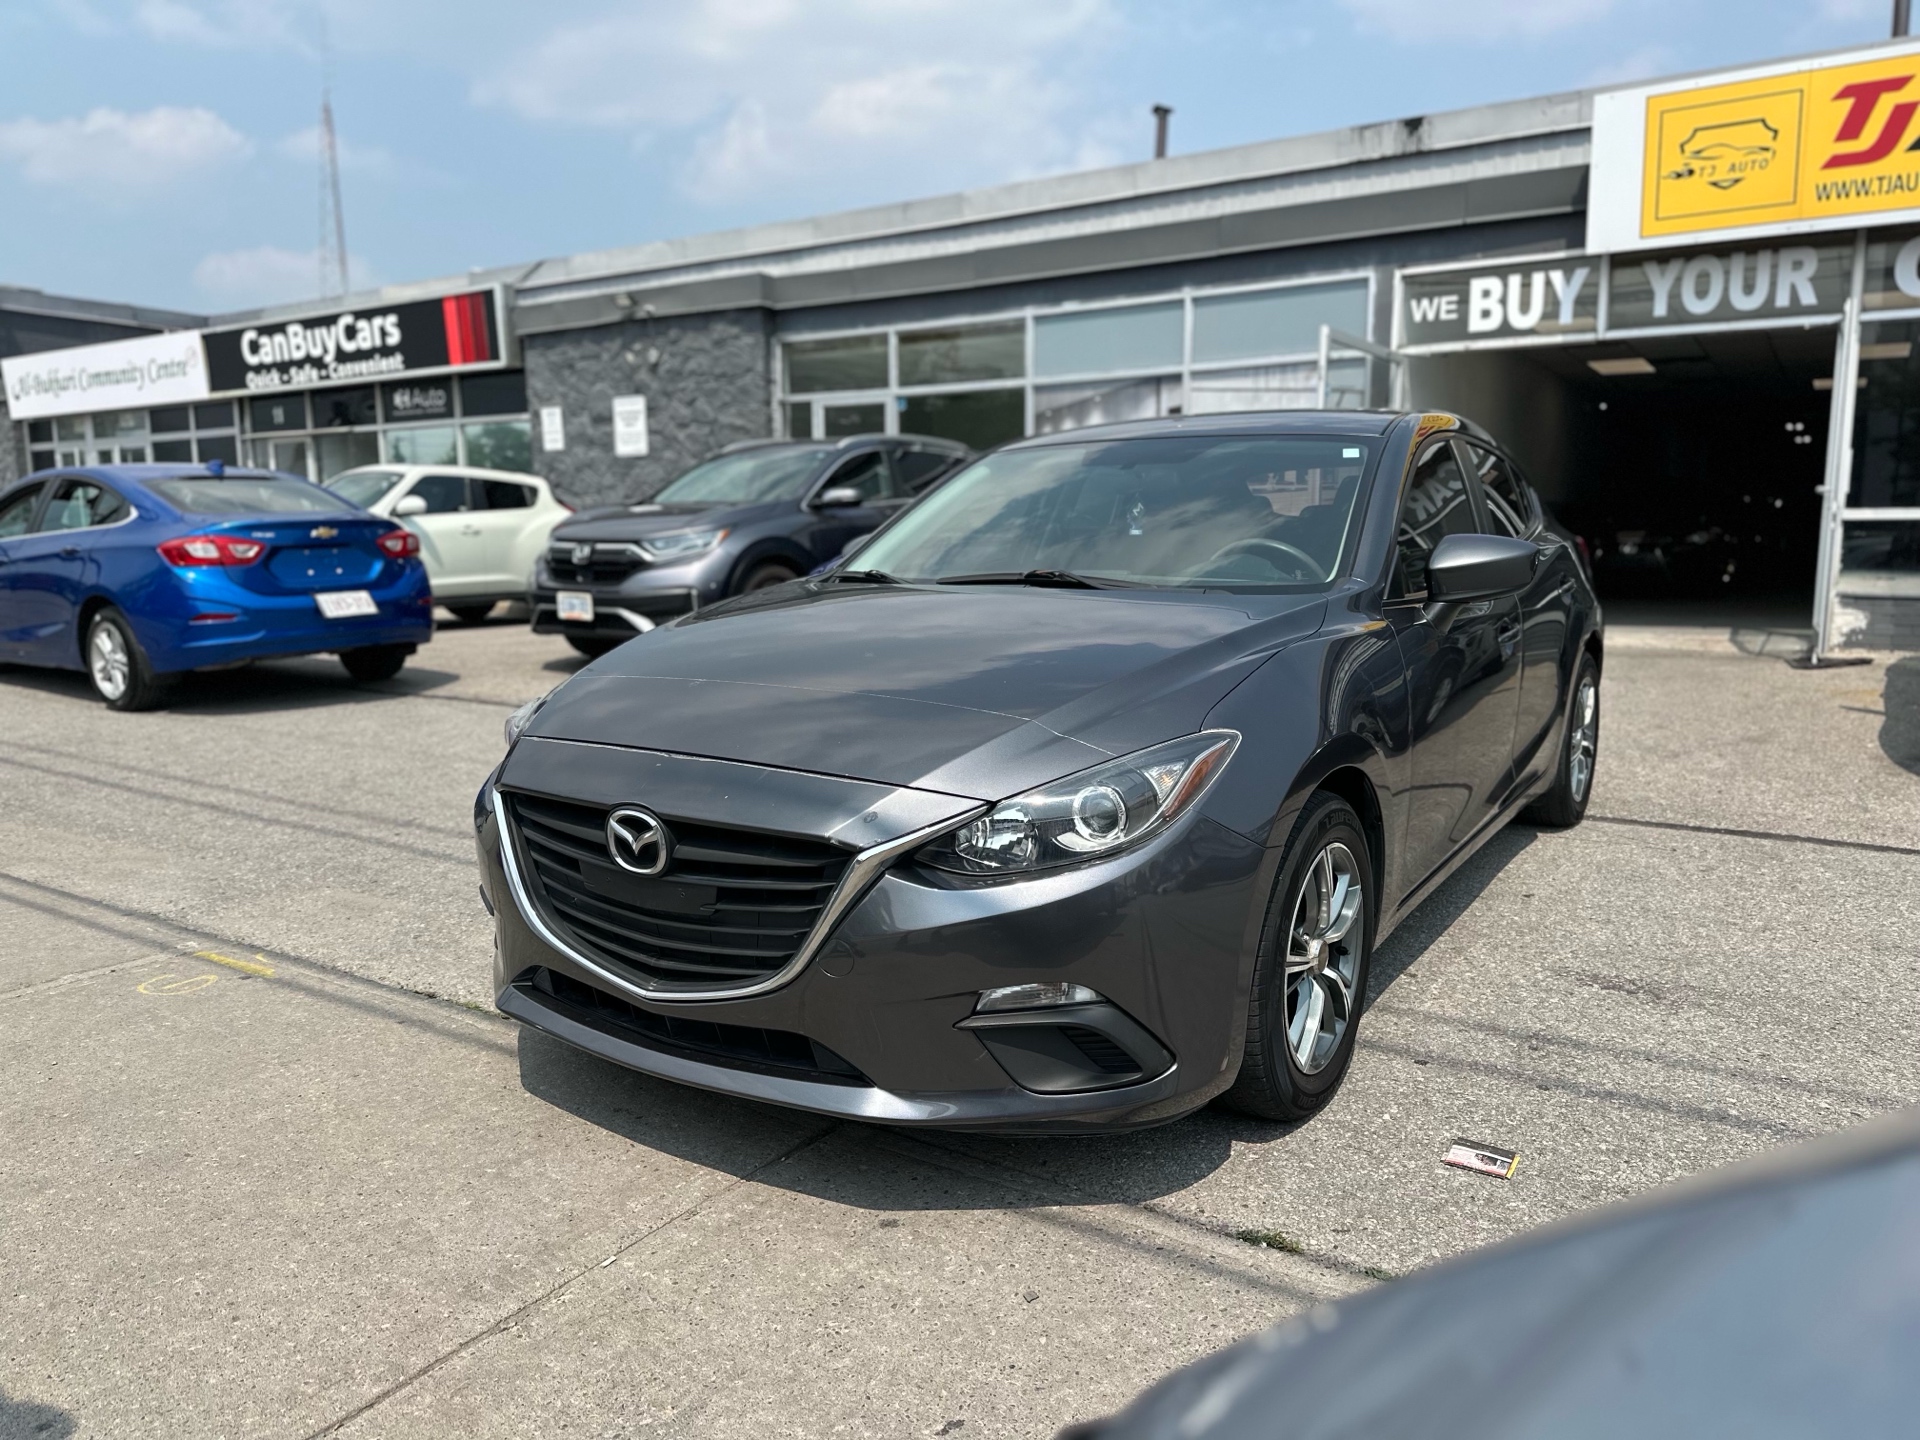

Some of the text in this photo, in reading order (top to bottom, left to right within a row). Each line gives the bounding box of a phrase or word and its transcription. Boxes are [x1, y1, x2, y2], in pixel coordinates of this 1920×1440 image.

[1698, 157, 1770, 178] TJ AUTO
[1815, 172, 1920, 202] WWW.TJAU
[1410, 294, 1459, 323] WE
[1467, 266, 1591, 334] BUY
[1642, 246, 1819, 318] YOUR
[240, 312, 402, 367] CanBuyCars
[78, 359, 145, 391] Community
[245, 351, 405, 390] Quick Safe Convenient
